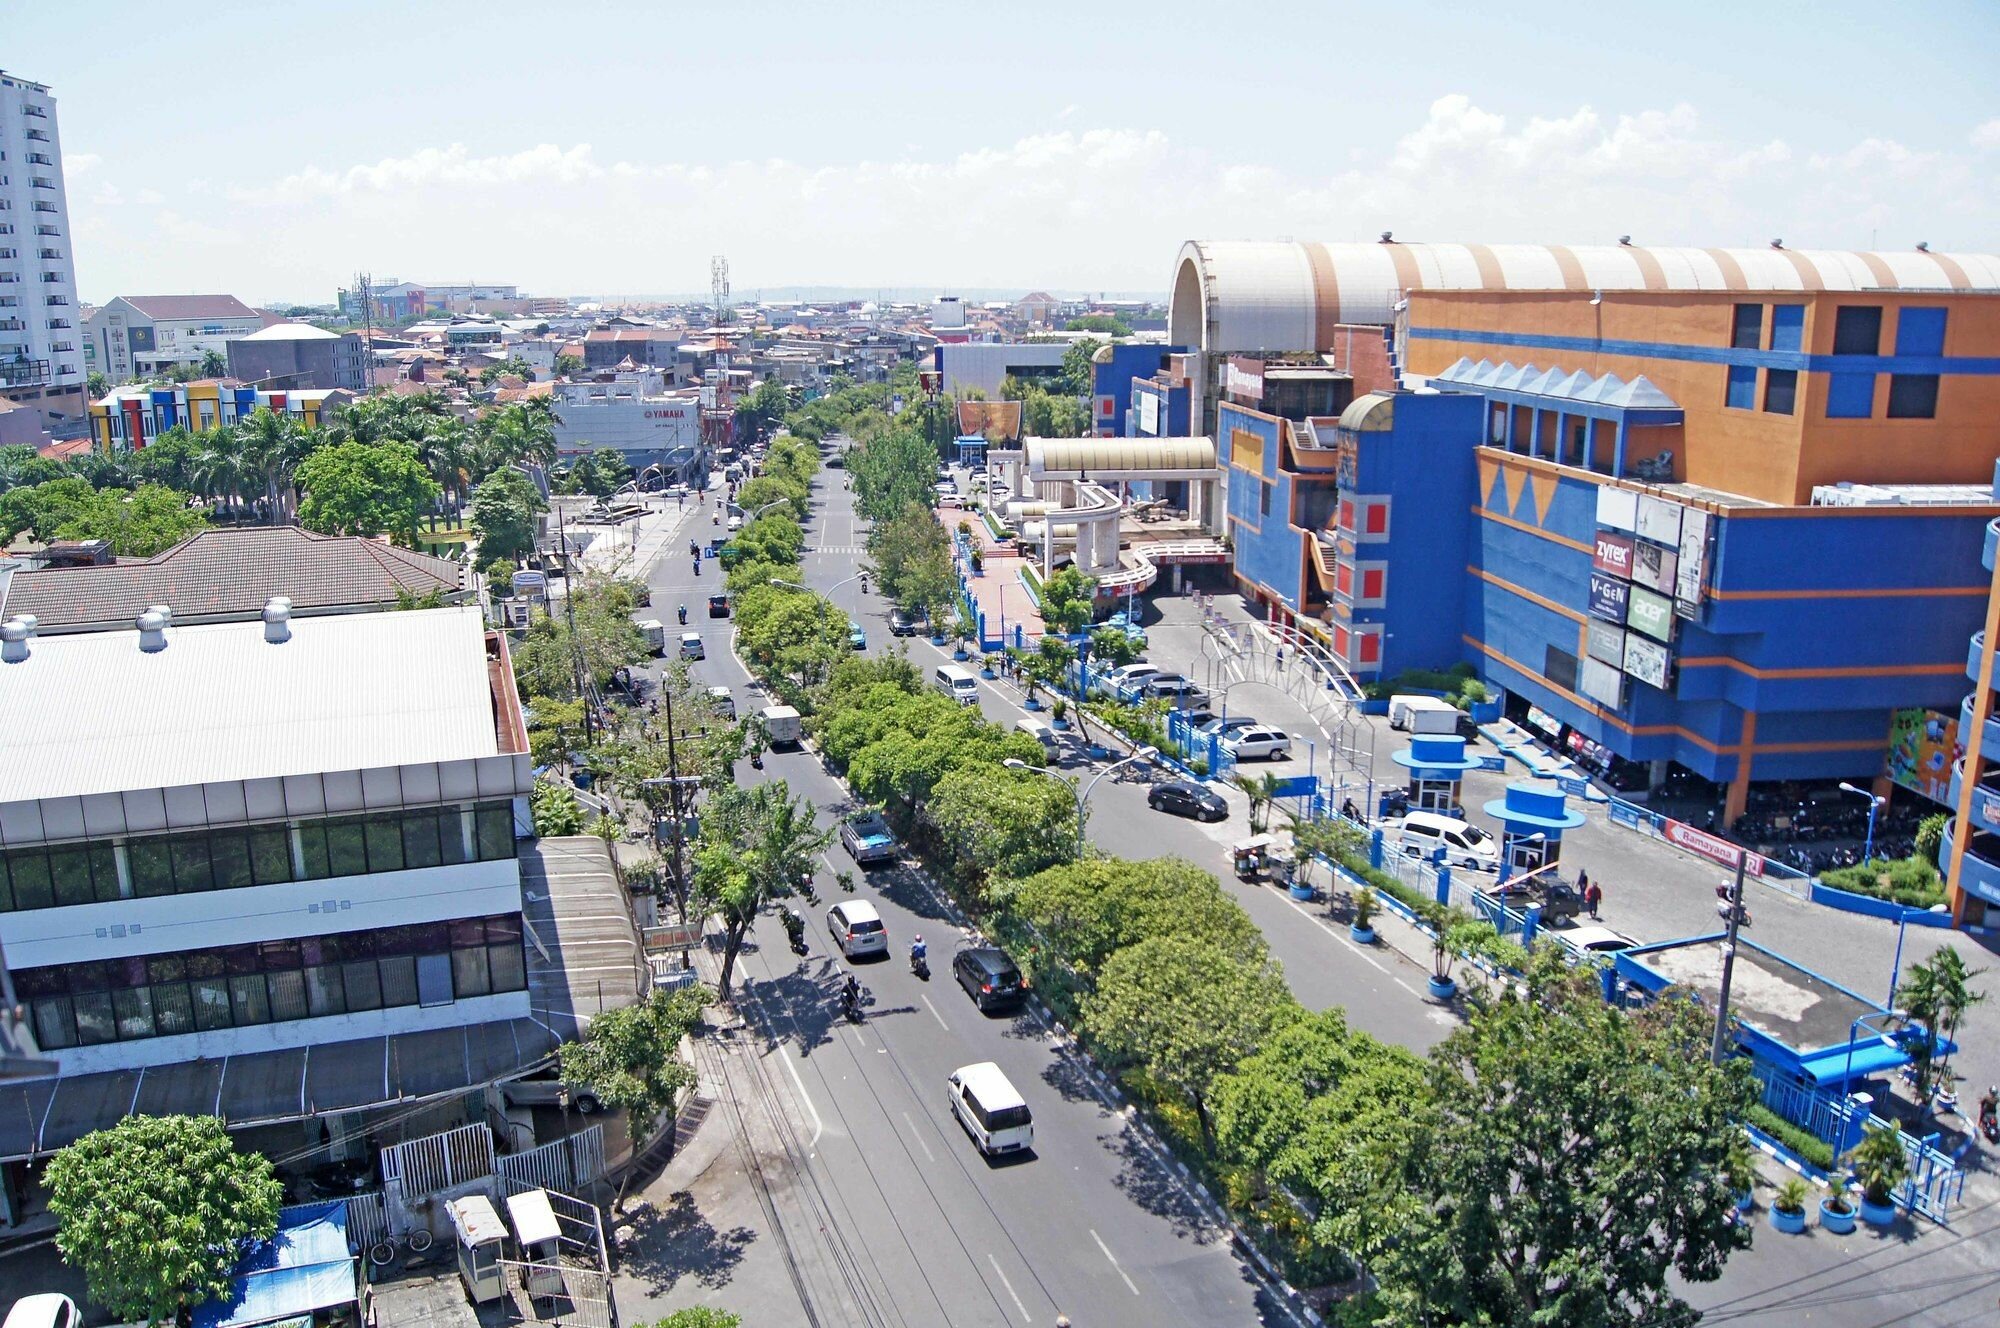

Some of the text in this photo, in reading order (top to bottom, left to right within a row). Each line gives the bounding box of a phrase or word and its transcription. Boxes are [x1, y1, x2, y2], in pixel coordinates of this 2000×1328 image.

[653, 410, 685, 419] YAMAHA
[1597, 540, 1627, 563] zyrex
[1634, 598, 1666, 622] acer
[1683, 831, 1732, 859] Ramayana
